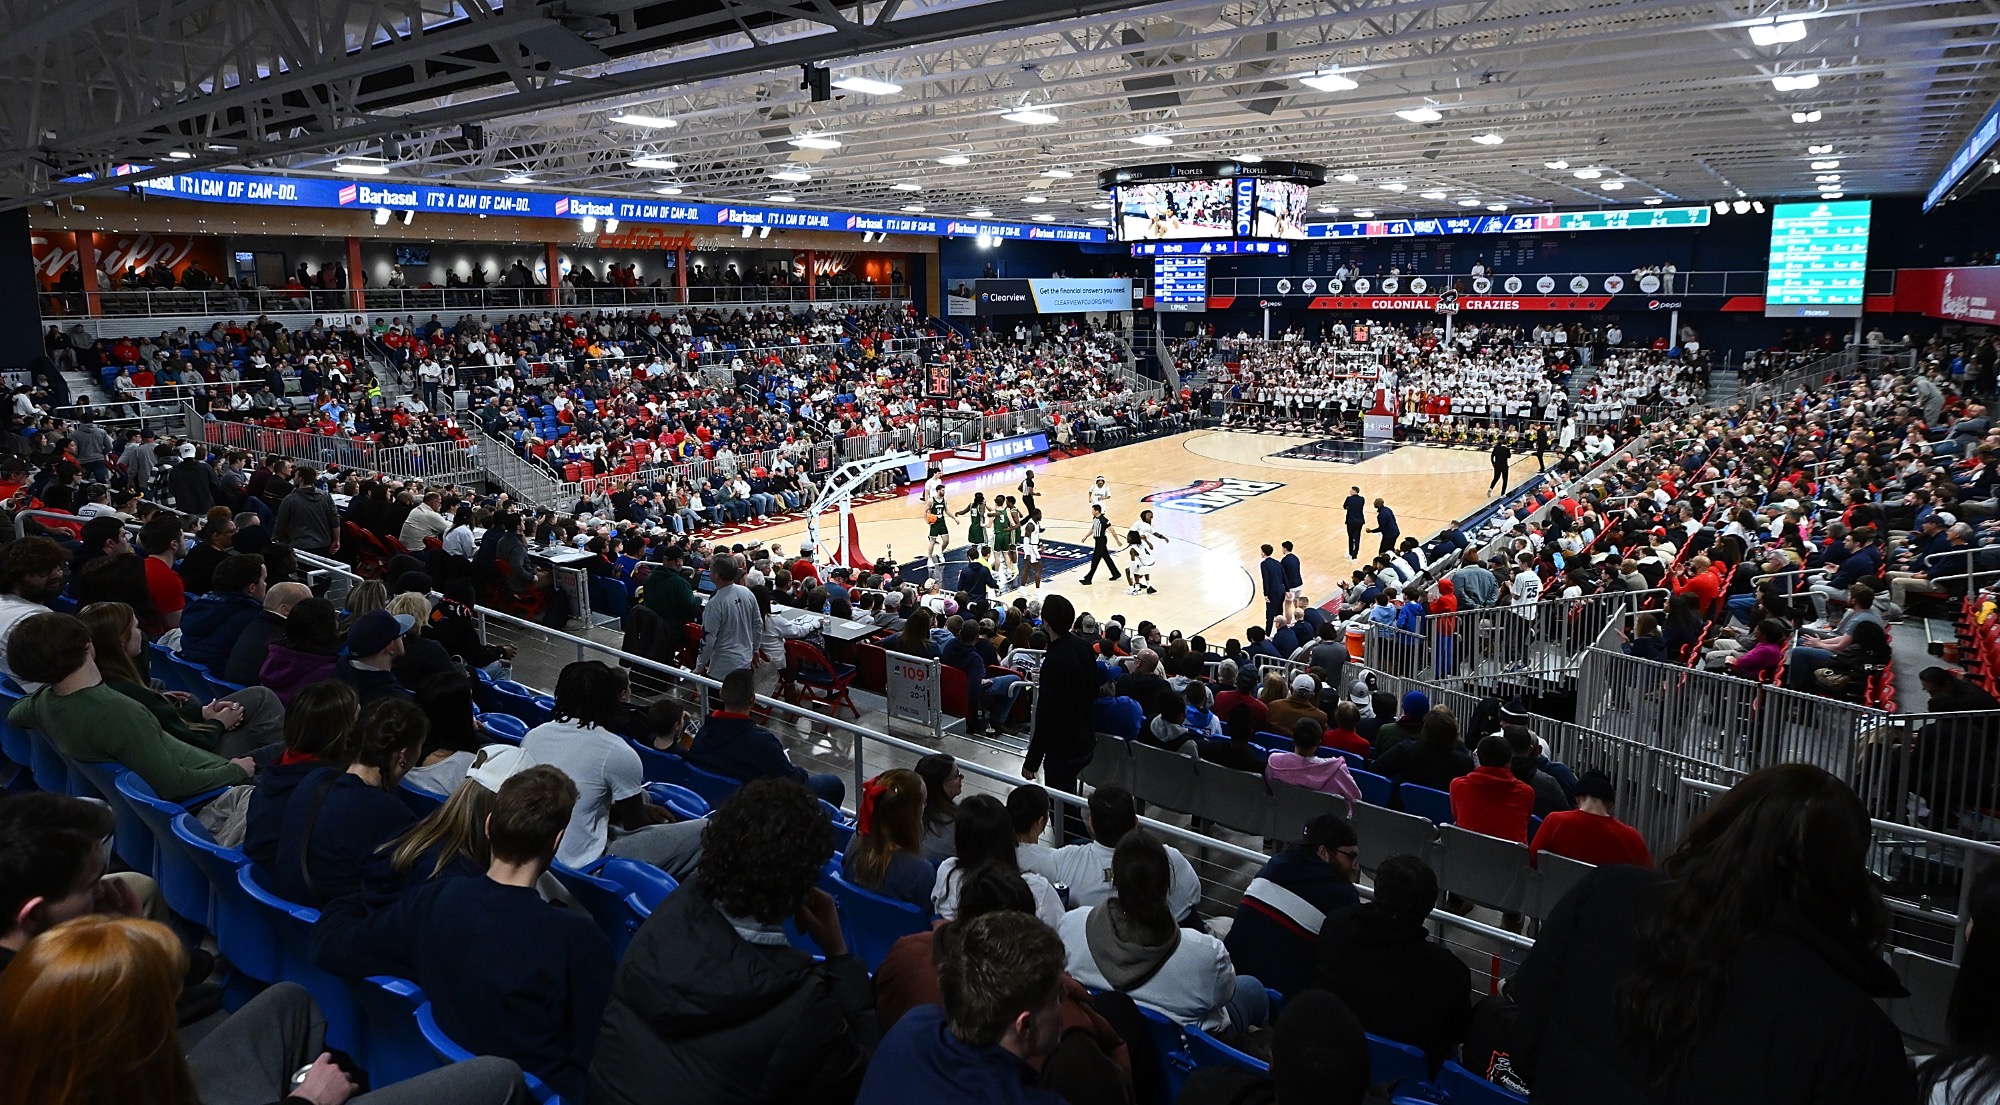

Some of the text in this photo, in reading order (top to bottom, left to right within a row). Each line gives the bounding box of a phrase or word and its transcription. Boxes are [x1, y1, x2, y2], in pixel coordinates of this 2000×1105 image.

[180, 175, 194, 192] IT'S
[194, 178, 200, 194] A
[201, 179, 223, 197] CAN
[227, 182, 244, 198] OF
[248, 182, 298, 200] CAN-DO.
[359, 186, 531, 212] Barbasol. IT'S A CAN OF CAN-DO.
[570, 199, 699, 220] Barbasol. IT'S A CAN OF CAN-DO.
[1237, 180, 1252, 236] UPMC
[729, 210, 830, 227] Barbasol. IT'S A CAN OF CAN-DO.
[1514, 218, 1532, 229] 34
[1391, 223, 1404, 233] 41
[576, 235, 597, 249] THE
[697, 236, 720, 252] CLUB
[1103, 288, 1113, 296] you
[1372, 300, 1431, 309] COLONIAL
[1436, 303, 1460, 312] RMU
[1466, 300, 1519, 309] CRAZIES
[327, 317, 342, 325] 112
[932, 376, 948, 394] 30
[1527, 587, 1538, 598] 25
[902, 666, 925, 681] 109
[914, 684, 925, 692] A-J
[910, 692, 926, 700] 20-1
